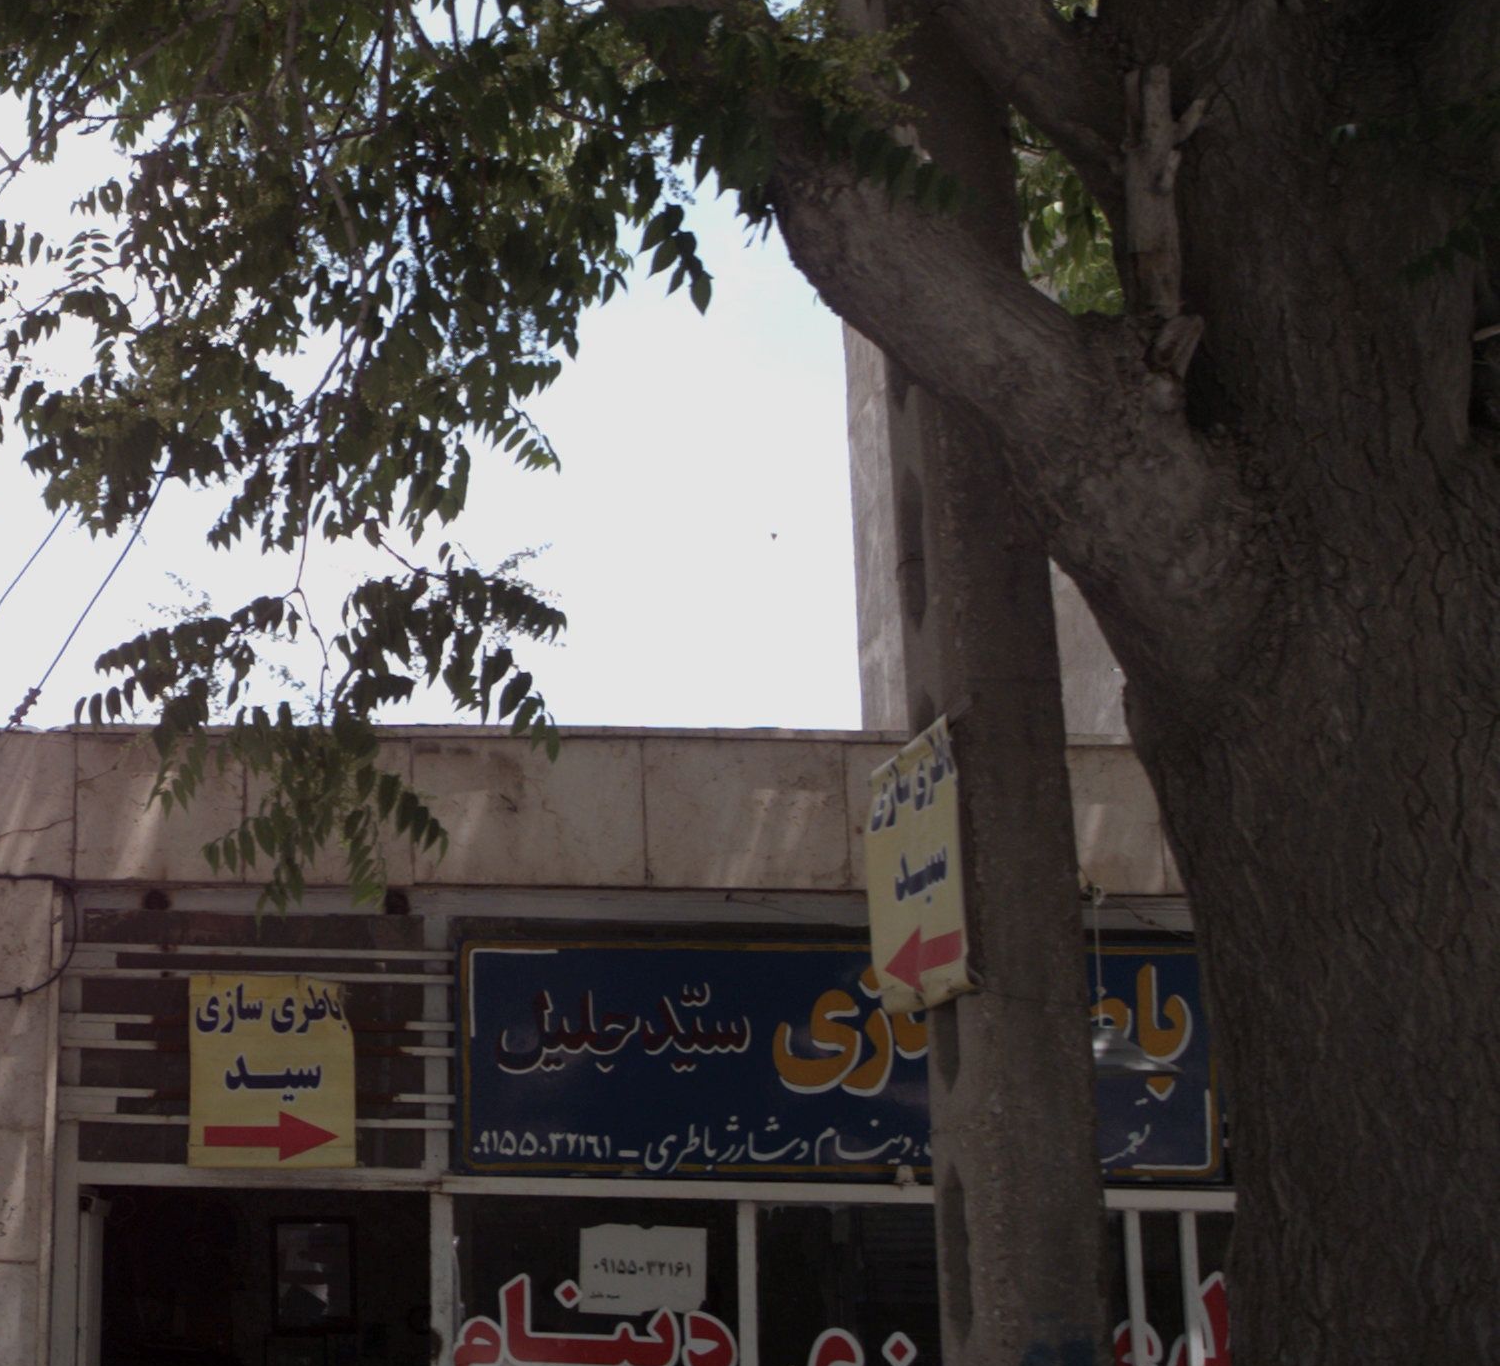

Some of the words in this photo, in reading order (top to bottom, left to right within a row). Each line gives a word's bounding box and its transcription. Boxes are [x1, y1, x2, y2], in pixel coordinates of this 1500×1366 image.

[895, 846, 946, 902] سید
[195, 983, 263, 1034] سازی
[270, 985, 347, 1034] باطری
[496, 989, 641, 1075] جلیل
[225, 1054, 321, 1102] سید
